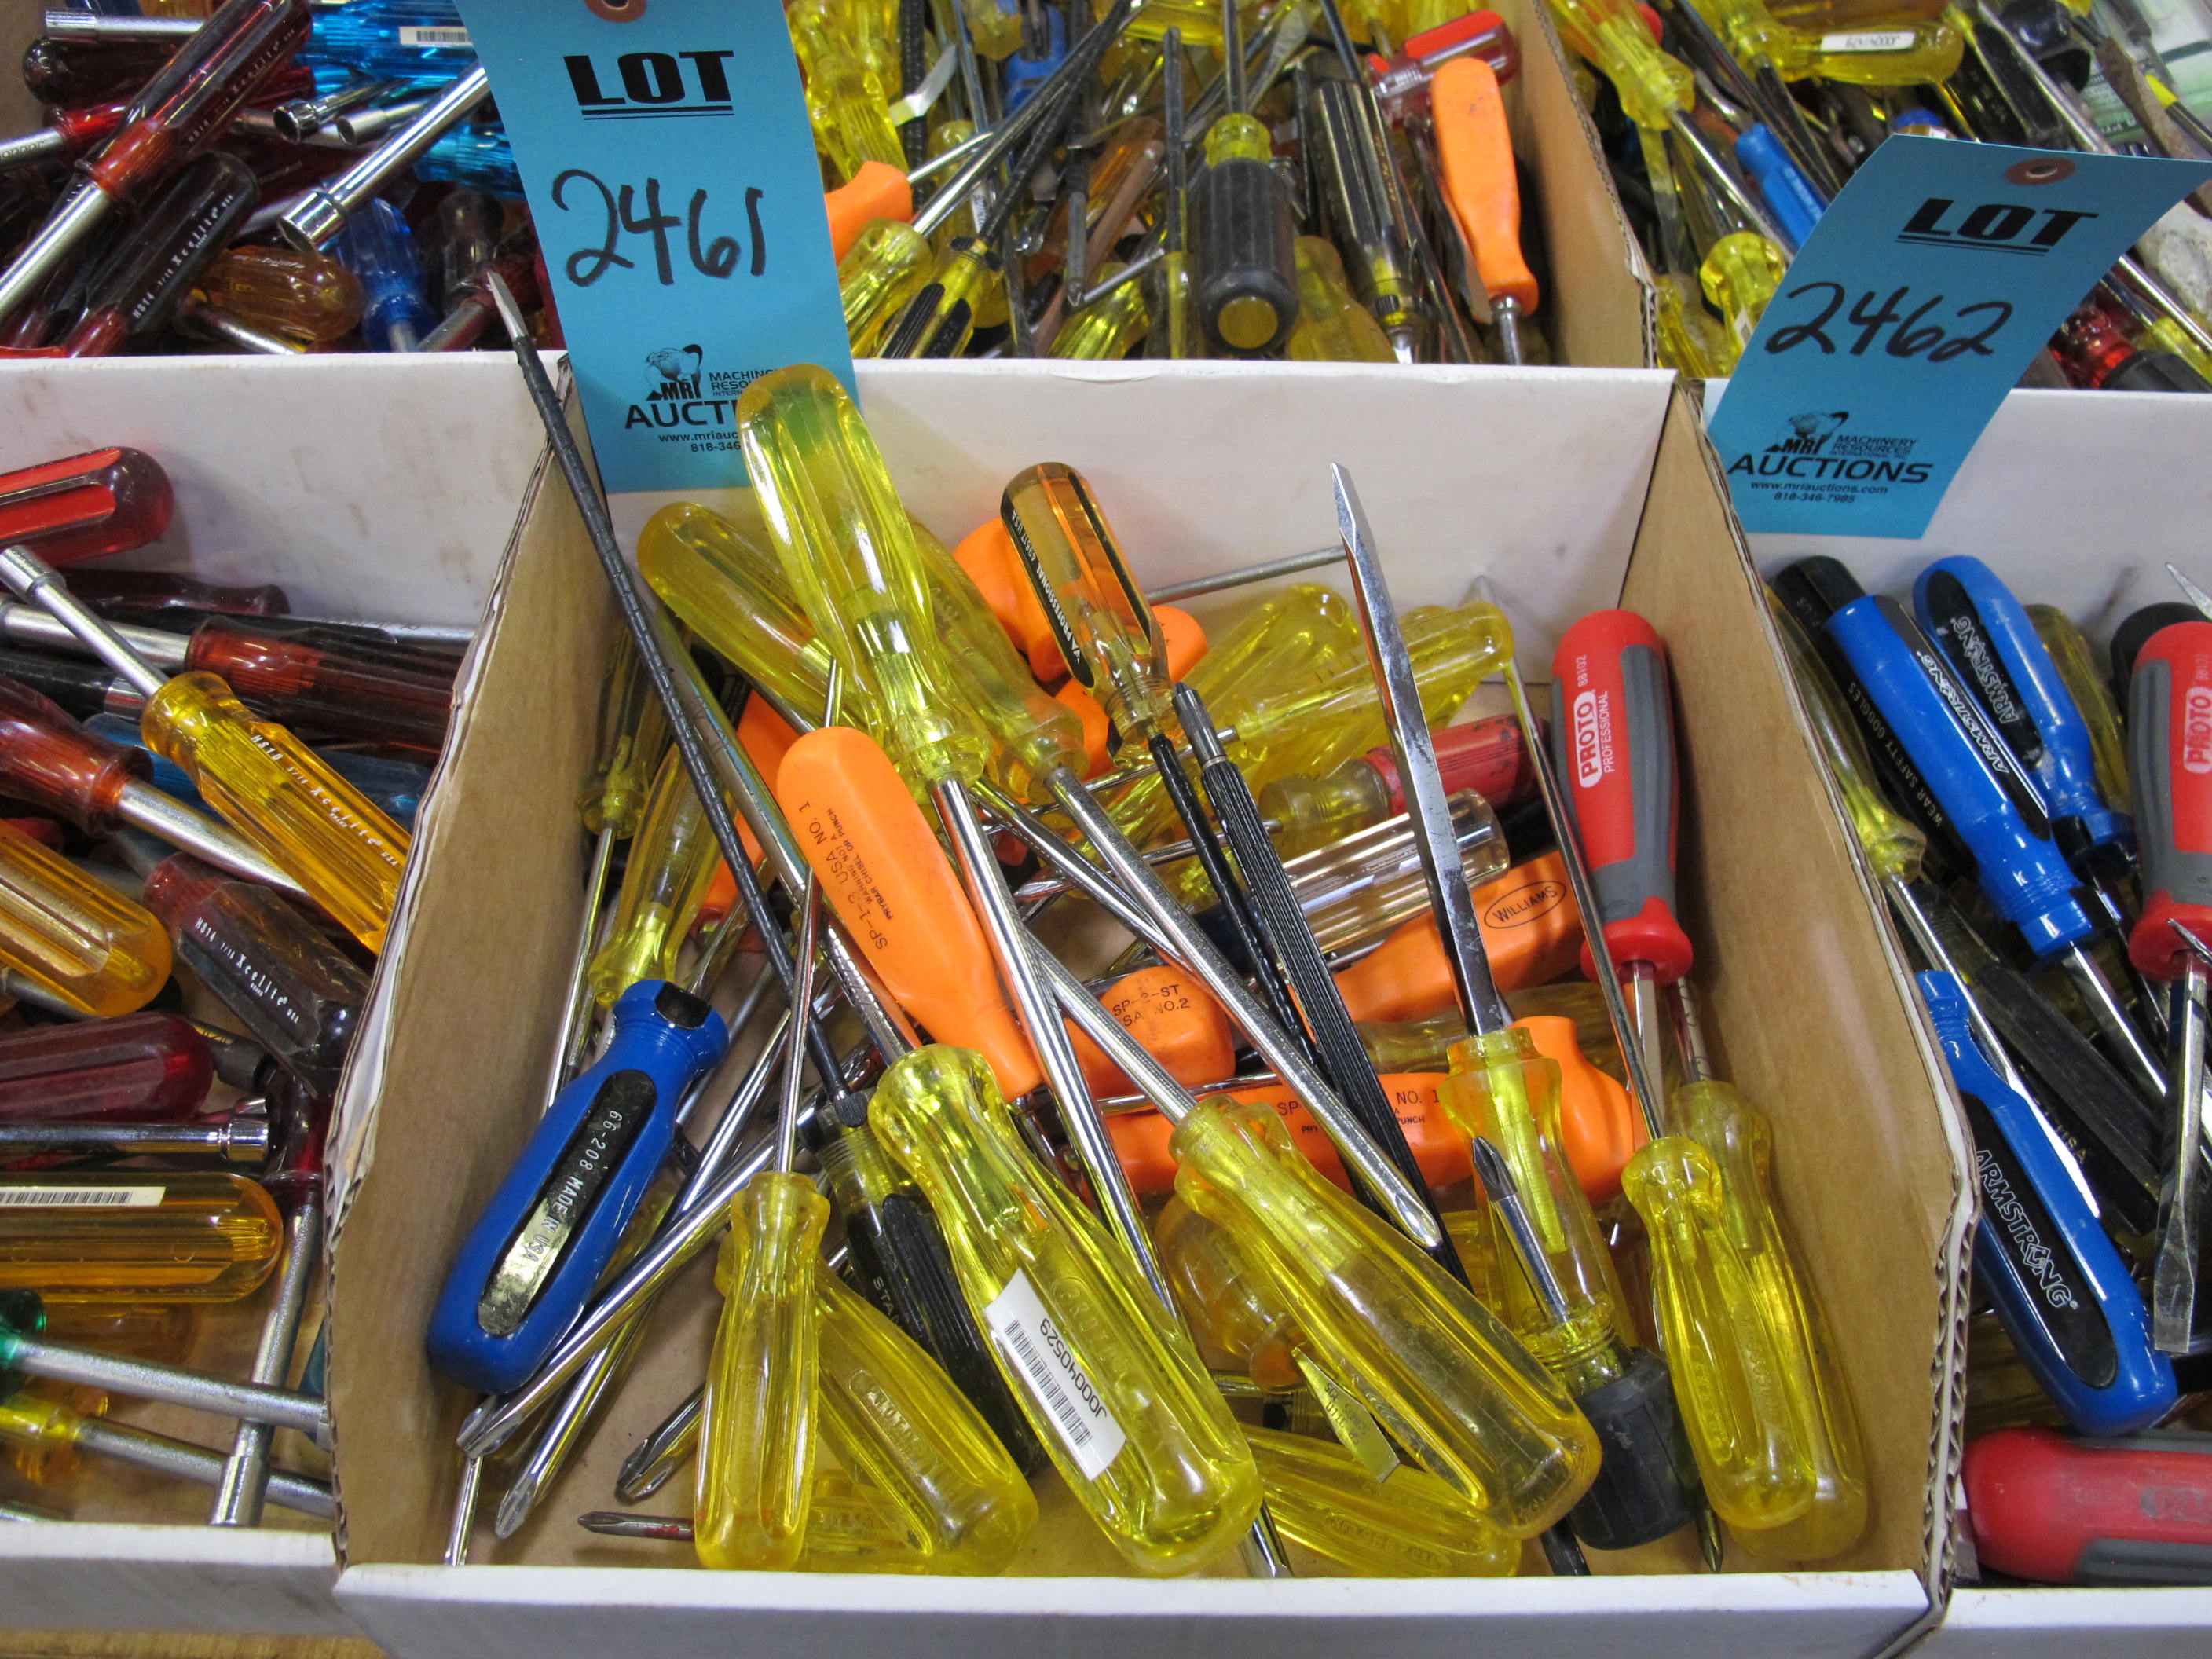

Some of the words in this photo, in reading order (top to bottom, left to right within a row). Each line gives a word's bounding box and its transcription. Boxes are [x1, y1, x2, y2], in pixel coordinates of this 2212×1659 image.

[563, 50, 734, 106] LOT
[552, 169, 766, 287] 2461
[1903, 198, 2099, 247] LOT
[1765, 281, 2013, 364] 2462
[659, 380, 702, 401] MRI
[709, 368, 773, 382] MACHIN
[712, 380, 752, 391] RESO
[1780, 435, 1827, 455] MRI
[1836, 435, 1917, 445] MACHINERY
[1728, 454, 1934, 483] AUCTIONS
[1751, 481, 1888, 495] www.mriauctions.com
[1774, 492, 1856, 504] 818-346-7985
[1036, 562, 1072, 642] PROFESSIONAL
[1848, 681, 1885, 739] GOGGLES
[1577, 701, 1599, 778] PROTO
[1598, 690, 1615, 774] PROFESSIONAL
[1884, 739, 1918, 787] SAFETY
[799, 800, 811, 813] 1
[827, 808, 845, 837] PUNCH
[1917, 790, 1943, 827] WEAR
[809, 817, 826, 845] NO.
[843, 838, 854, 851] OR
[826, 848, 848, 885] USA
[837, 845, 849, 862] NOT
[853, 852, 873, 884] CHISEL
[847, 864, 873, 904] WARNING
[848, 892, 888, 950] SP-1-3
[871, 887, 893, 921] PRYBAR
[1492, 885, 1558, 923] WILLIAMS
[1396, 1090, 1423, 1104] NO.
[579, 1110, 623, 1170] 66-208
[552, 1176, 584, 1214] MADE
[541, 1216, 560, 1232] IN
[1976, 1150, 2072, 1309] ARMSTRONG
[524, 1233, 550, 1262] USA
[1039, 1317, 1108, 1418] J00040529
